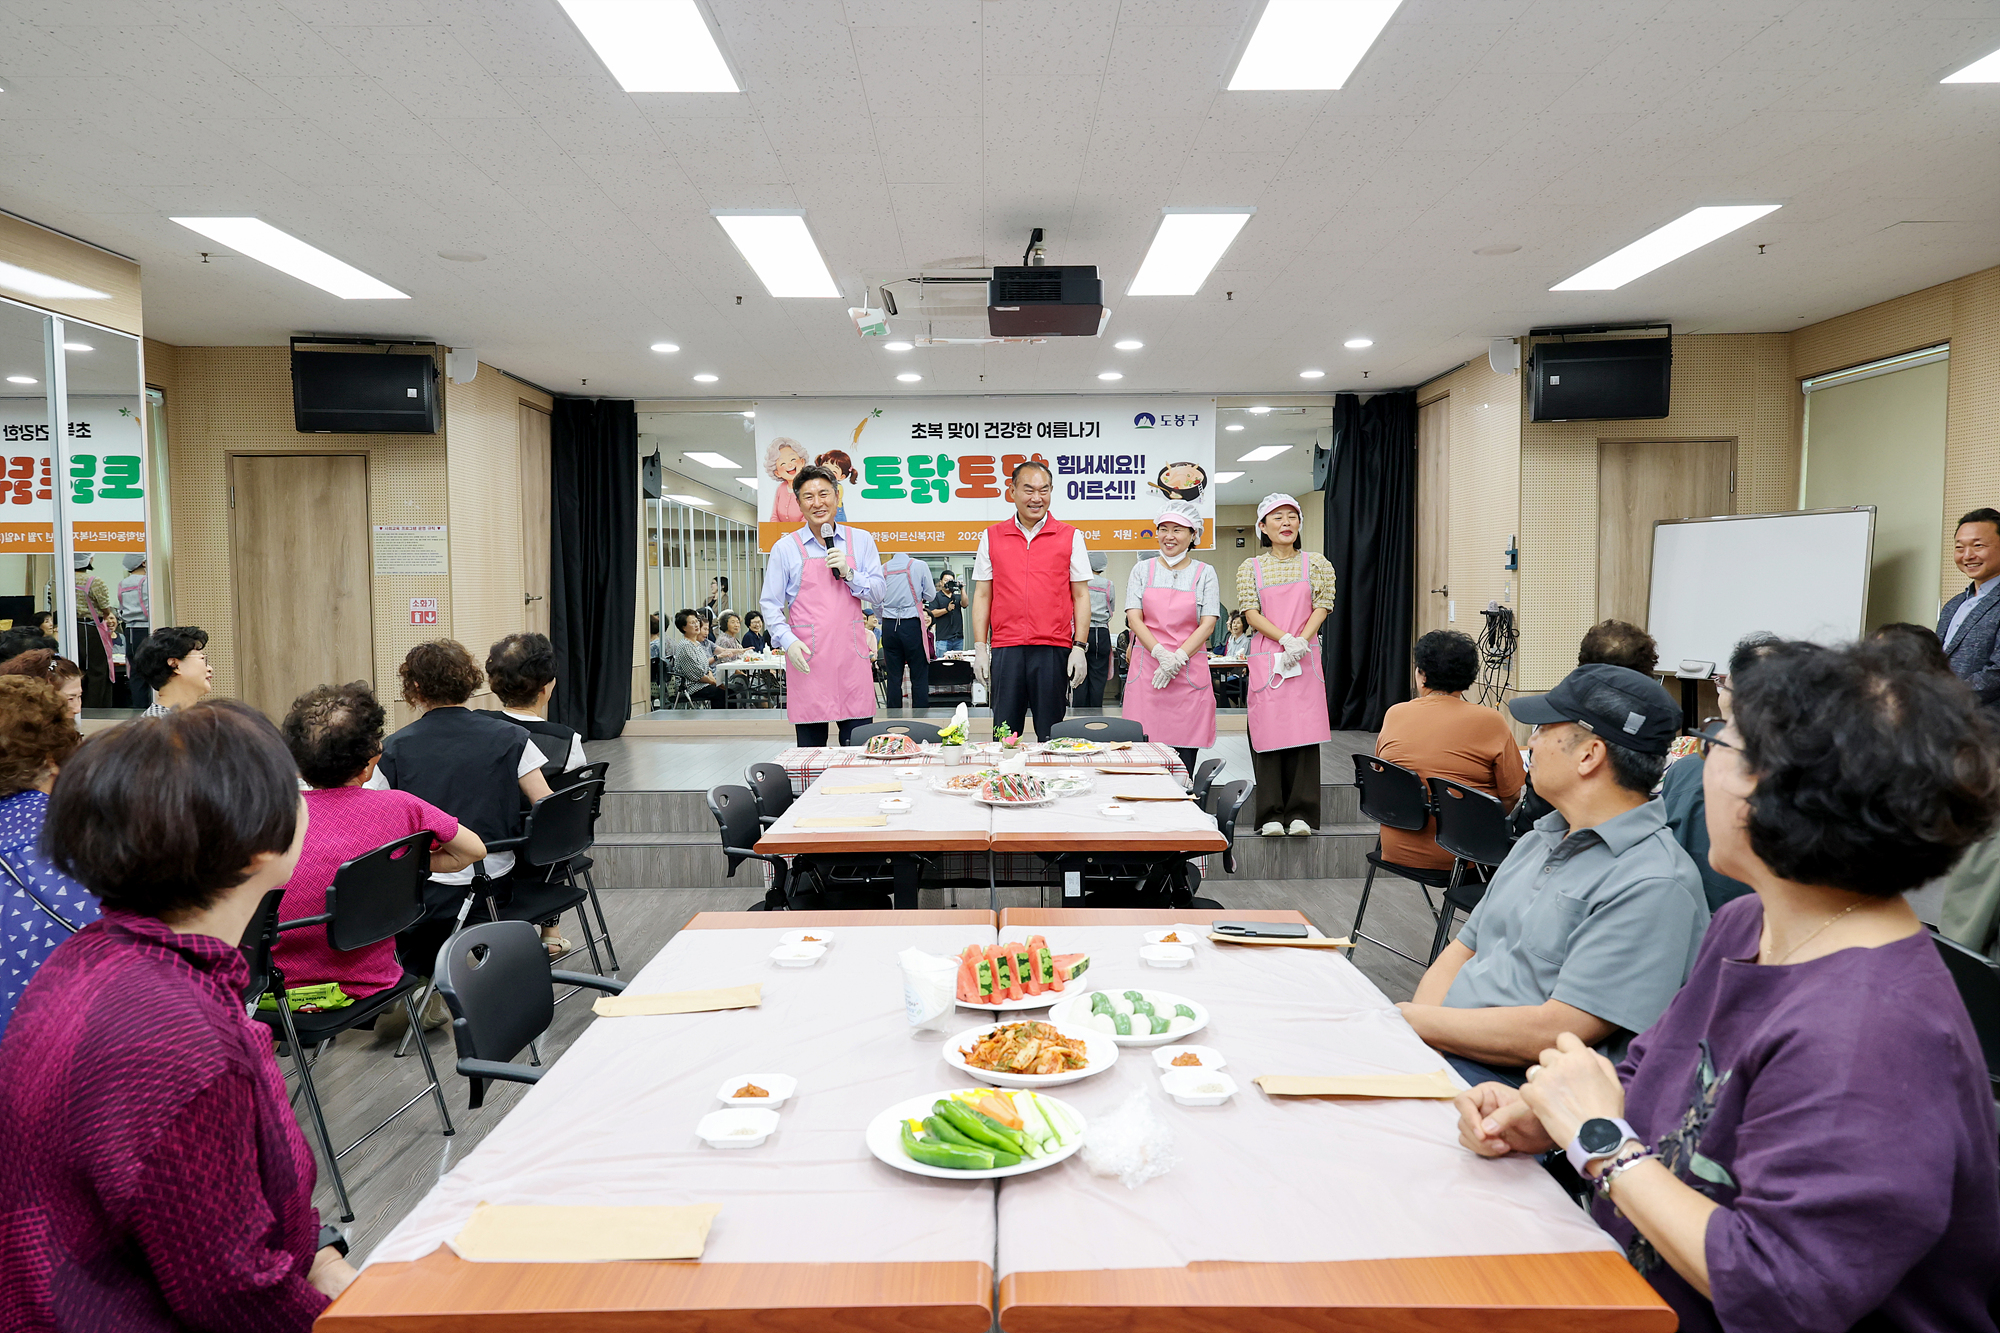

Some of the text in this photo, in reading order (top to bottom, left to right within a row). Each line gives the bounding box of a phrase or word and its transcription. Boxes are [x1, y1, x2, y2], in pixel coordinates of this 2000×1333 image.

[1160, 414, 1200, 428] 도봉구
[911, 421, 1101, 439] 초복 맞이 건강한 여름나기
[1056, 455, 1147, 475] 힘내세요!!
[1066, 480, 1136, 501] 어르신!!
[1113, 529, 1132, 540] 지원
[412, 599, 435, 607] 소화기
